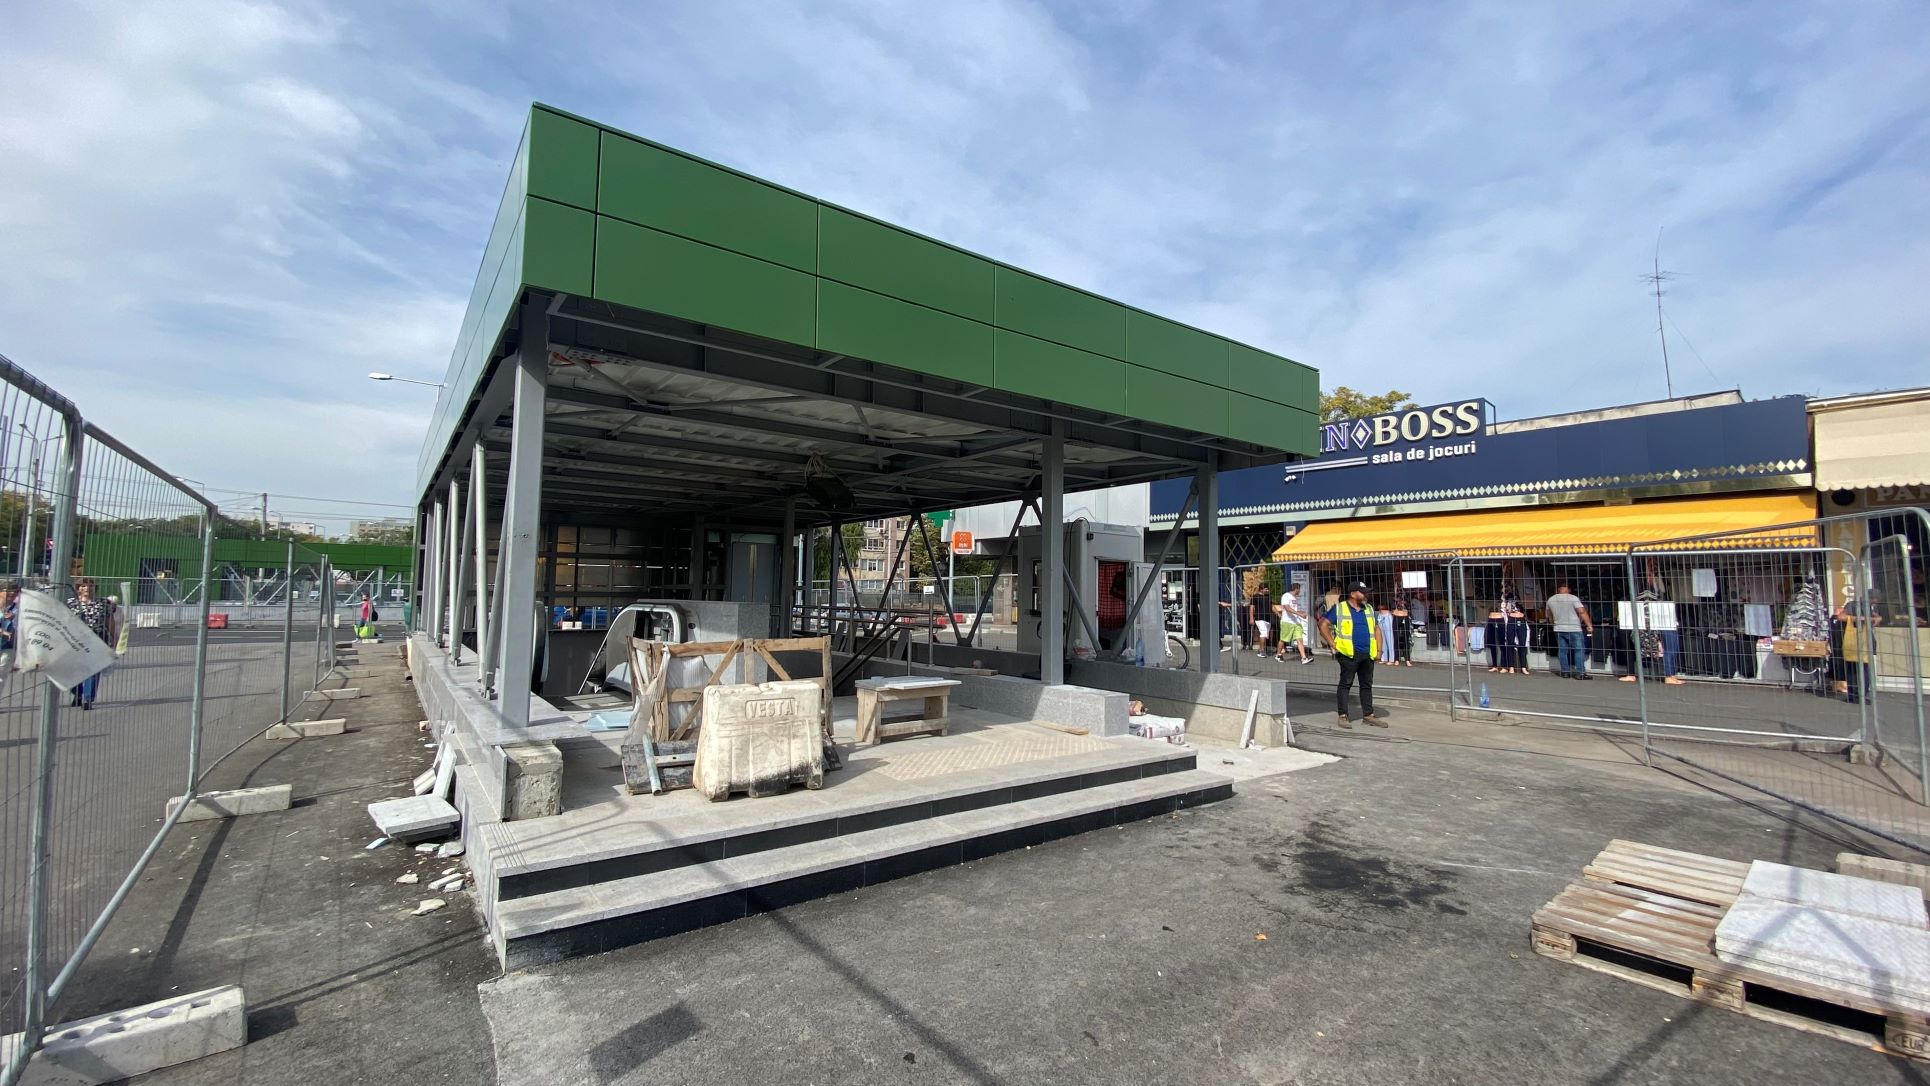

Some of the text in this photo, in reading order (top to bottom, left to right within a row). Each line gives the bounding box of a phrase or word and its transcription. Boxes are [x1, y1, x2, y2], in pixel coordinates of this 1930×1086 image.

[1372, 402, 1480, 447] BOSS
[1372, 441, 1477, 464] sala de jocuri
[748, 699, 795, 719] VESTA
[1901, 1034, 1925, 1052] EUR
